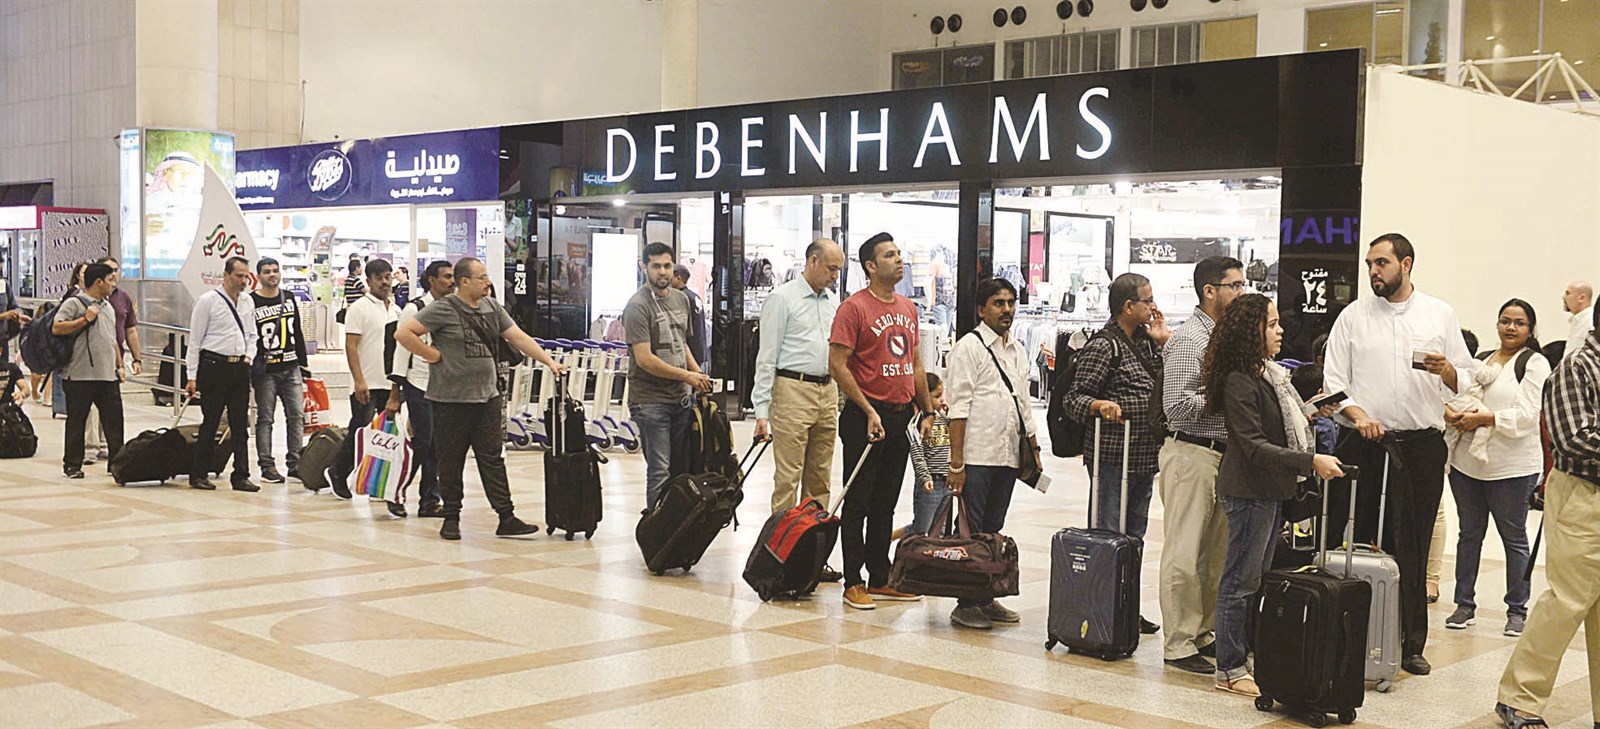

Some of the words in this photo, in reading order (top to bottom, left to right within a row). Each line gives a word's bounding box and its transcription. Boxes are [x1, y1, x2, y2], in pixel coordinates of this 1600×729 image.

[606, 86, 1113, 184] DEBENHAMS
[384, 149, 460, 185] صيدلية
[58, 215, 99, 227] SNACKS
[1301, 268, 1328, 281] مفتوح
[514, 278, 527, 290] 24
[1301, 303, 1328, 314] ساعة
[882, 363, 904, 377] EST.
